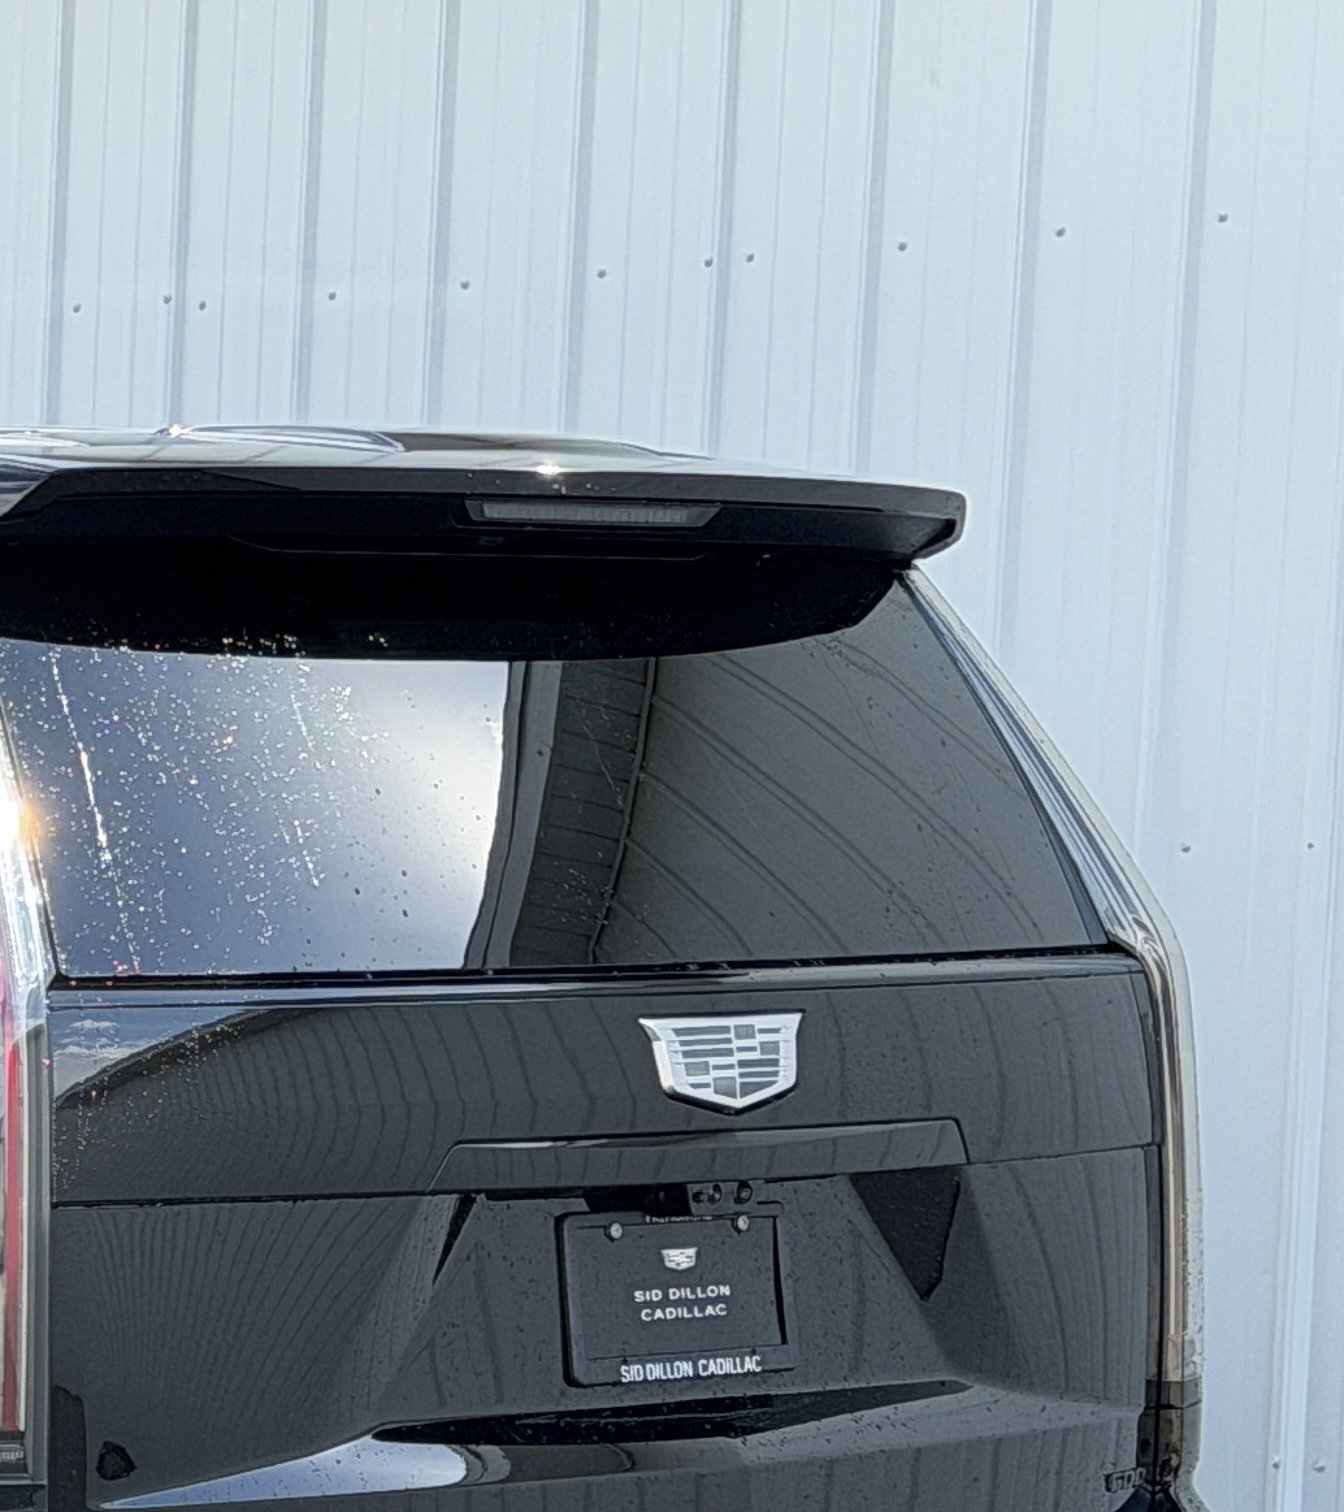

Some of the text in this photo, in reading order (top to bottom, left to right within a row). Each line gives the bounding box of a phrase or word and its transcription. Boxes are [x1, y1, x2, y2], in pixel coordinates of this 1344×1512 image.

[634, 1285, 730, 1302] SID DILLON
[640, 1303, 727, 1321] CADILLAC
[620, 1356, 762, 1382] SID DILLON CADILLAC
